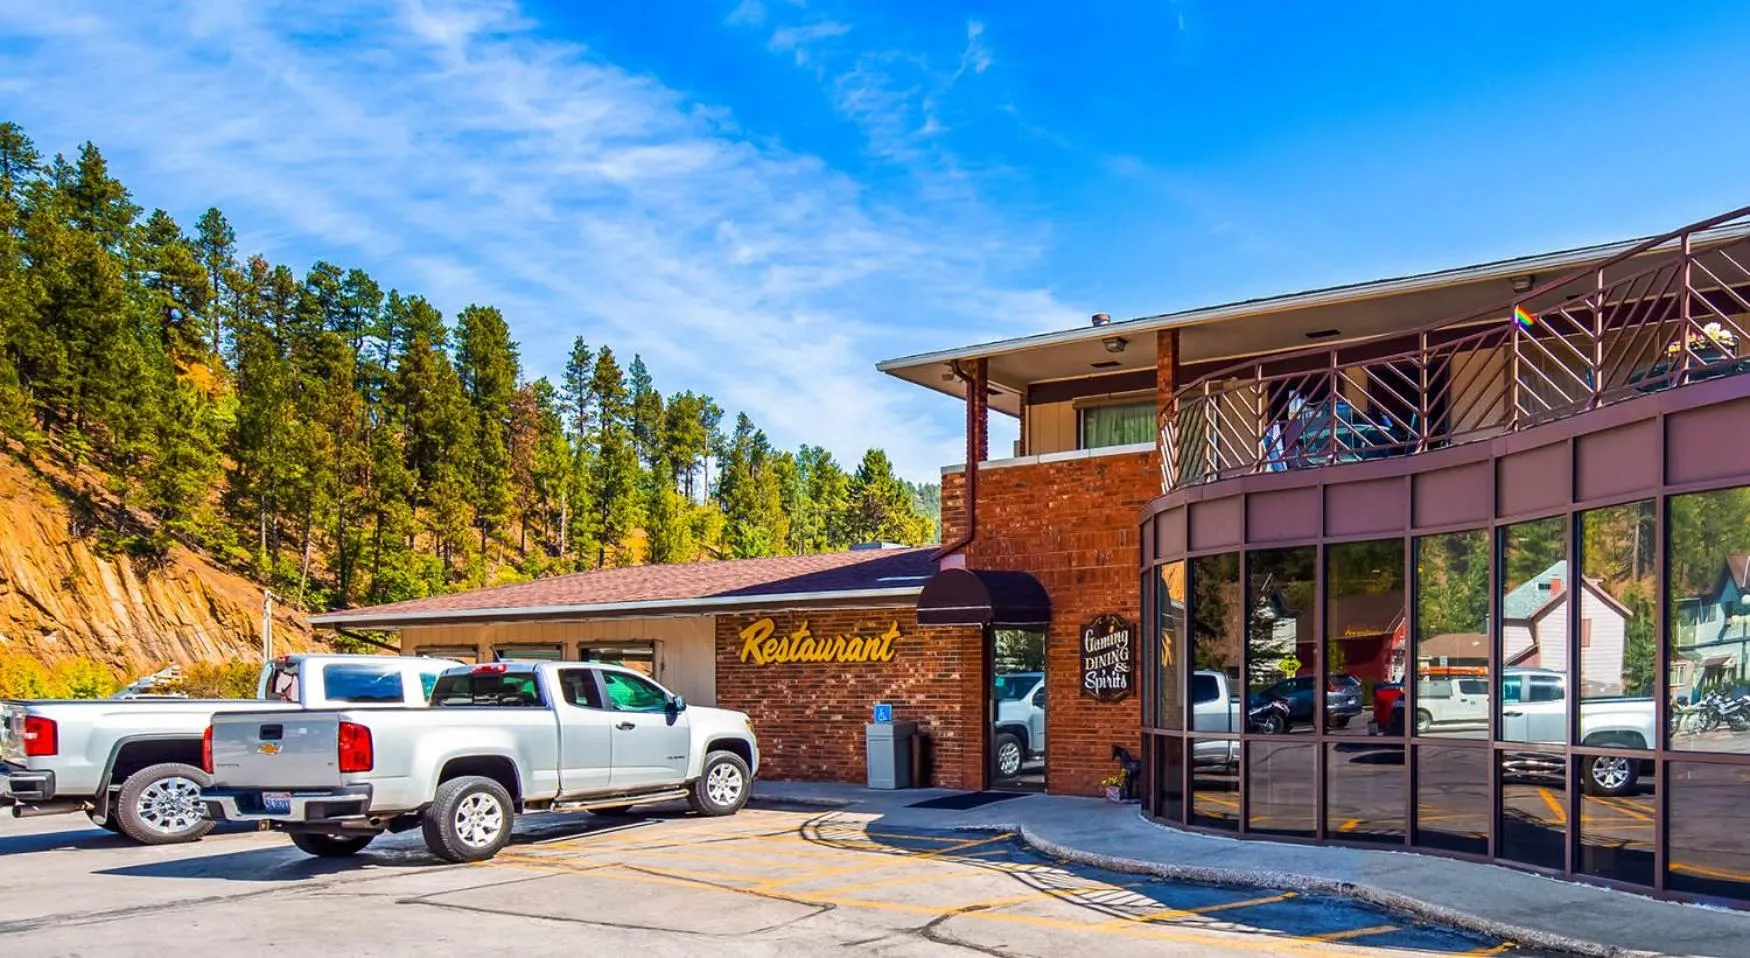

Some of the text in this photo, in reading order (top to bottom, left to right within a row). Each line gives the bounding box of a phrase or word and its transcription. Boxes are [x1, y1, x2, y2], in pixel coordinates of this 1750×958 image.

[739, 617, 901, 665] Restaurant
[1085, 627, 1129, 653] Gaming
[1085, 647, 1129, 670] DINING
[1114, 662, 1131, 673] &
[1084, 669, 1127, 694] Spirits
